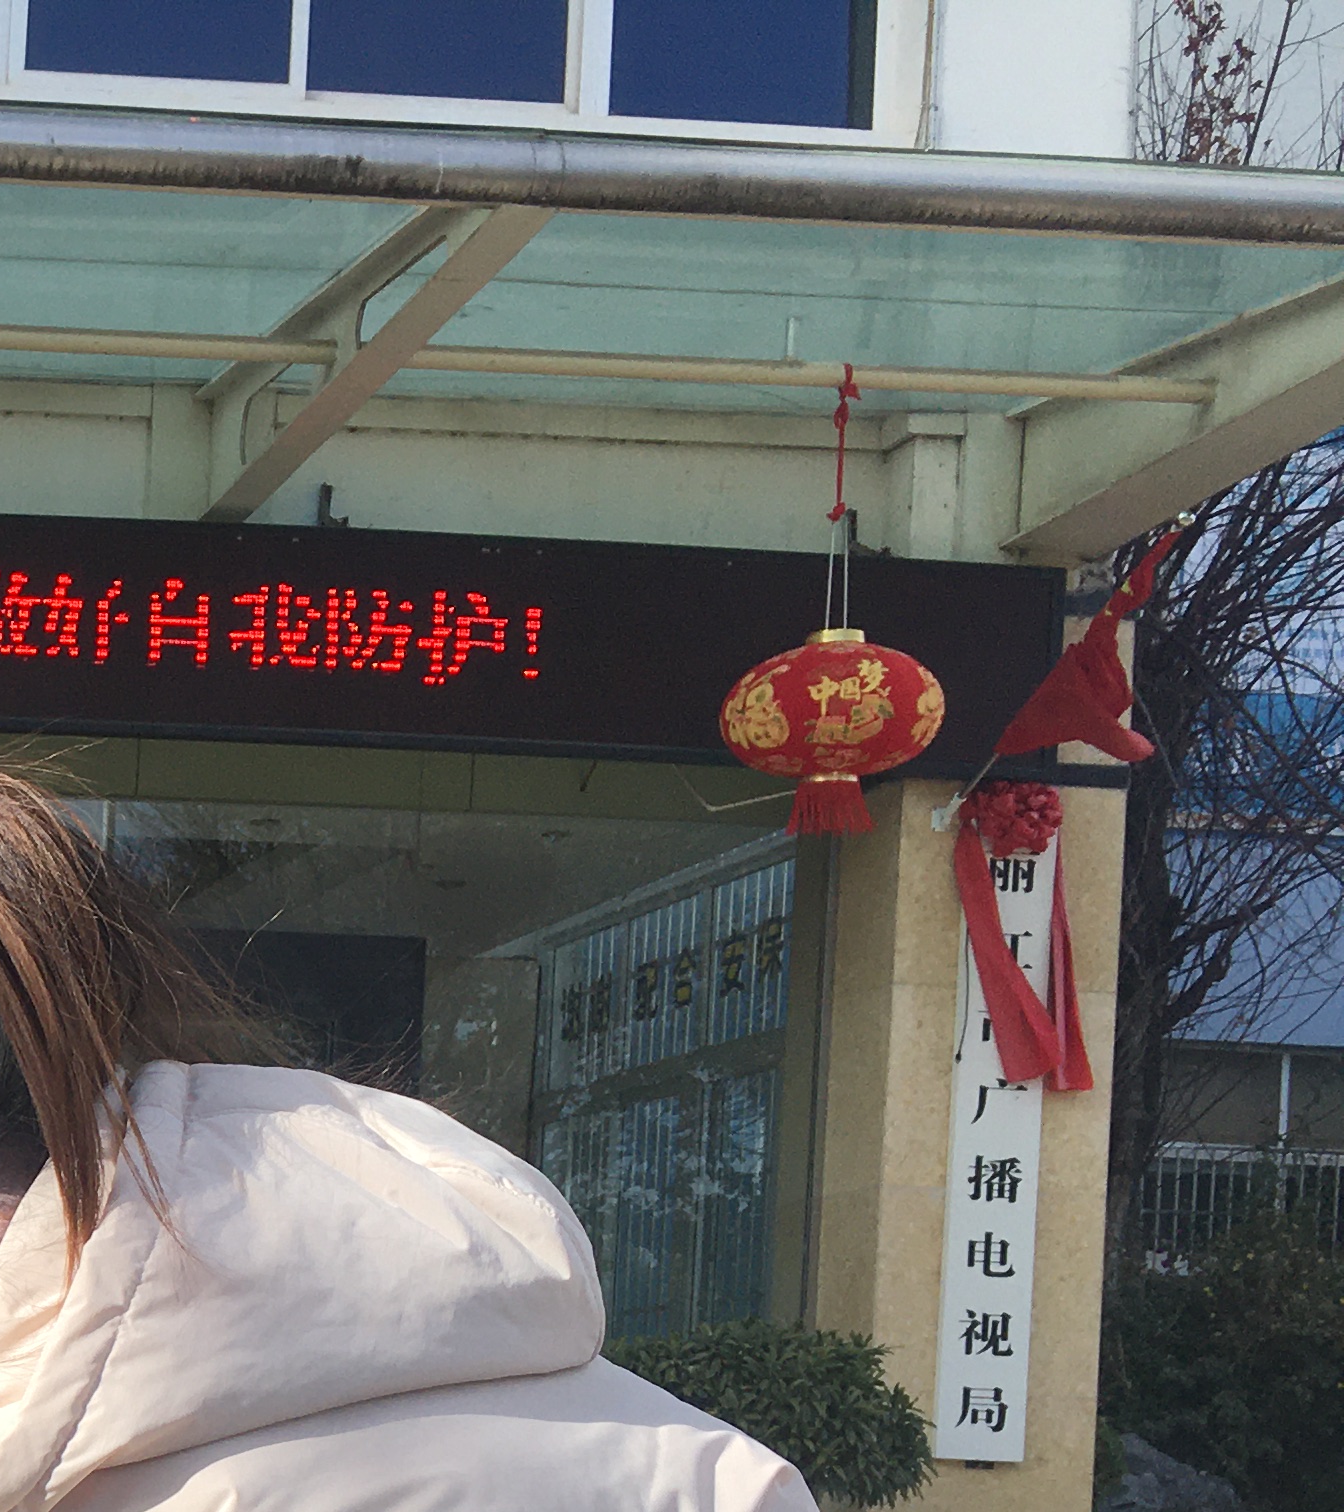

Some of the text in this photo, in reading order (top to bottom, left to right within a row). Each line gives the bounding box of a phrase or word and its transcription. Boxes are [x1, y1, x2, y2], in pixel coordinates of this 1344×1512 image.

[954, 850, 1035, 1433] 丽广播电视局
